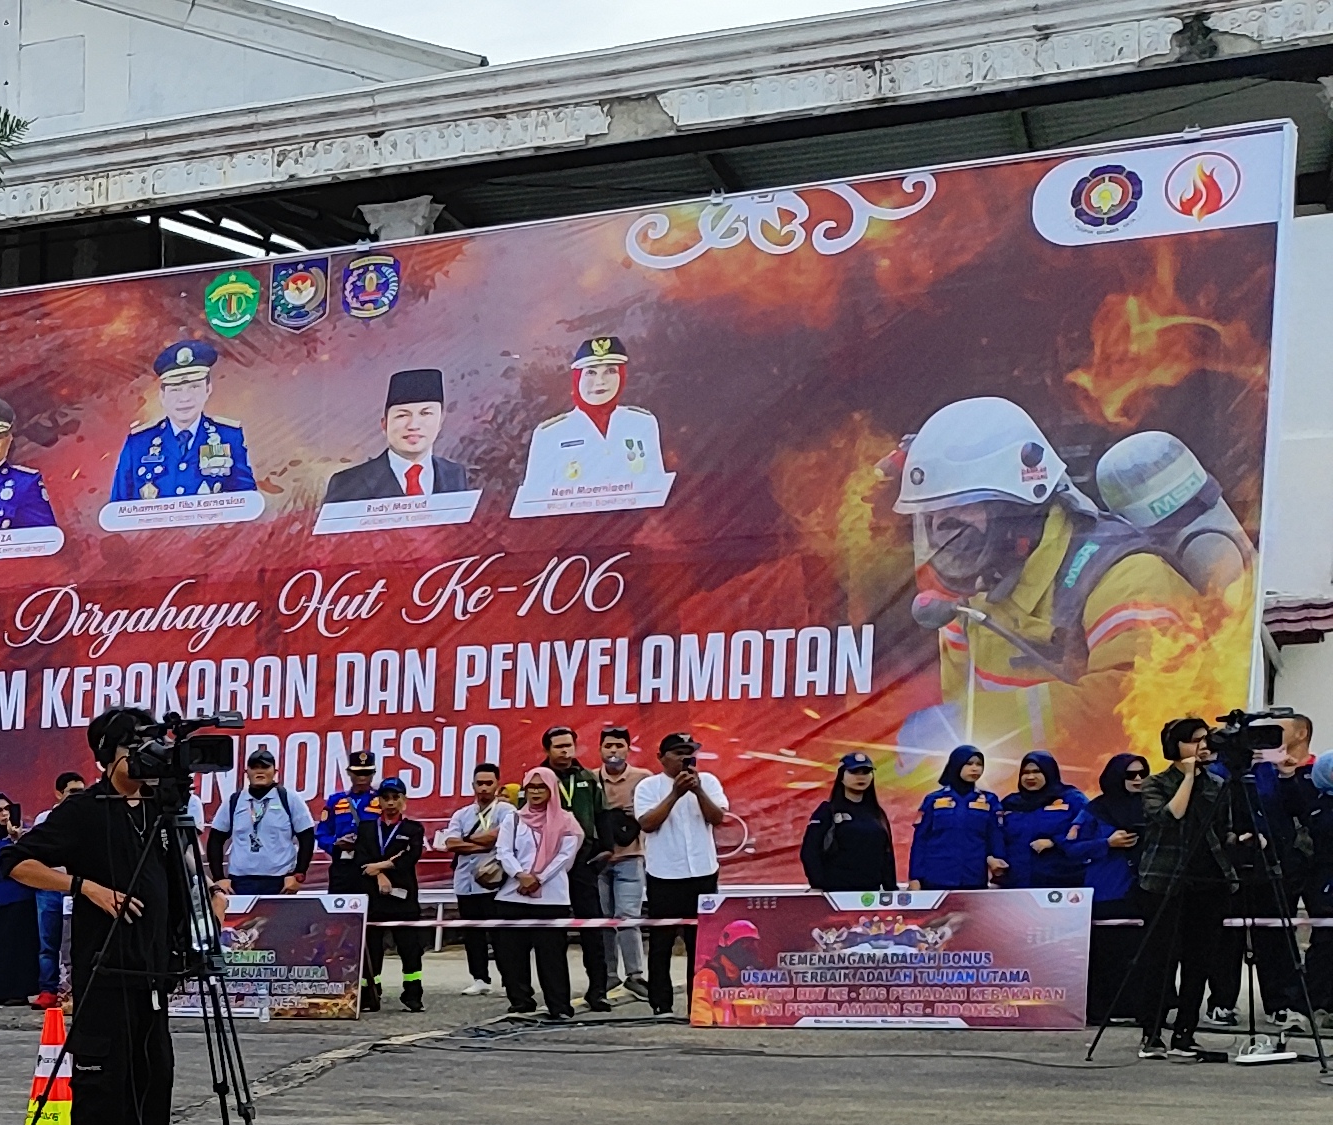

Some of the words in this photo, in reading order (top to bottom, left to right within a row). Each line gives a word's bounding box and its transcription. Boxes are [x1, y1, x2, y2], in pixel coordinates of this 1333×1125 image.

[3, 579, 261, 658] Dirgahayu
[277, 569, 389, 638] Hut
[401, 551, 632, 625] Ke-106
[40, 653, 319, 729] KEBAKARAN
[335, 646, 437, 717] DAN
[453, 624, 875, 711] PENYELAMATAN
[779, 952, 876, 967] KEMENANGAN
[881, 951, 939, 966] ADALAH
[941, 951, 993, 965] BONUS
[288, 966, 329, 979] JUARA
[742, 970, 789, 984] USAHA
[793, 970, 854, 984] TERBAIK
[856, 970, 914, 984] ADALAH
[918, 969, 976, 983] TUJUAN
[979, 969, 1031, 983] UTAMA
[859, 987, 887, 1001] 106
[889, 987, 967, 1001] PEMADAM
[969, 987, 1066, 1001] KEBAKARAN
